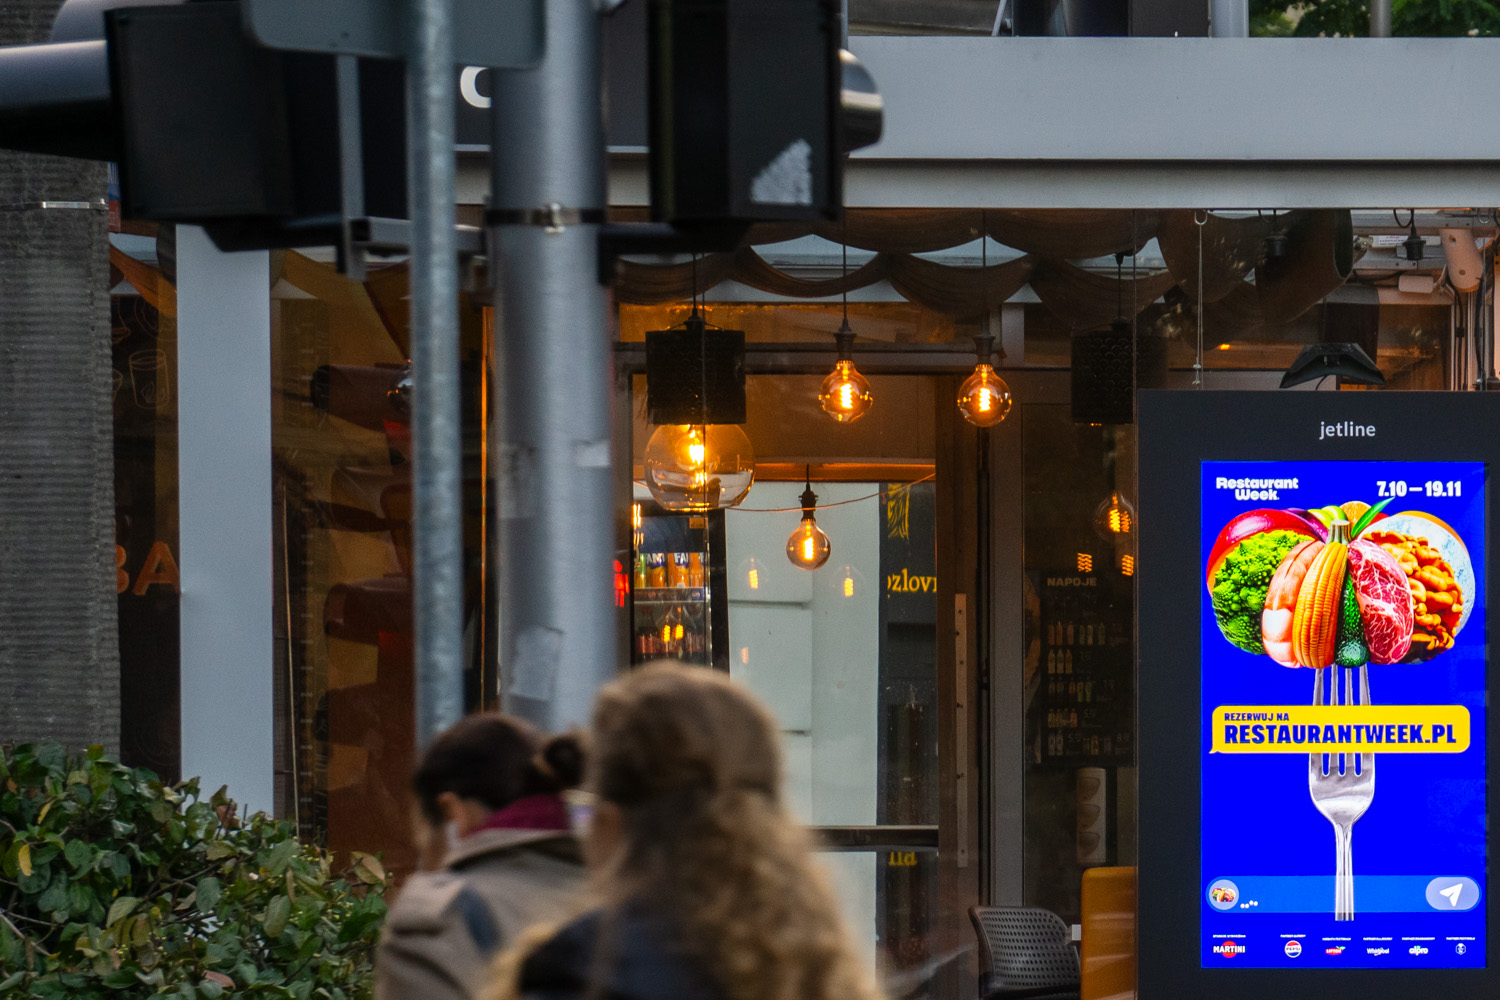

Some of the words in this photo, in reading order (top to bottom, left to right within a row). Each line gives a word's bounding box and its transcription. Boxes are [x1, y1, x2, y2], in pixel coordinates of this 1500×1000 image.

[1319, 421, 1376, 440] jetline
[1216, 477, 1299, 489] Restaurant
[1376, 480, 1407, 497] 7.10
[1425, 480, 1461, 497] 19.11
[1047, 577, 1097, 587] NAPOJE
[1224, 712, 1274, 721] REZERWUJ
[1276, 713, 1290, 721] NA
[1224, 724, 1457, 744] RESTAURANTWEEK.PL
[1213, 945, 1246, 954] MARTINI
[1408, 945, 1430, 957] alpro
